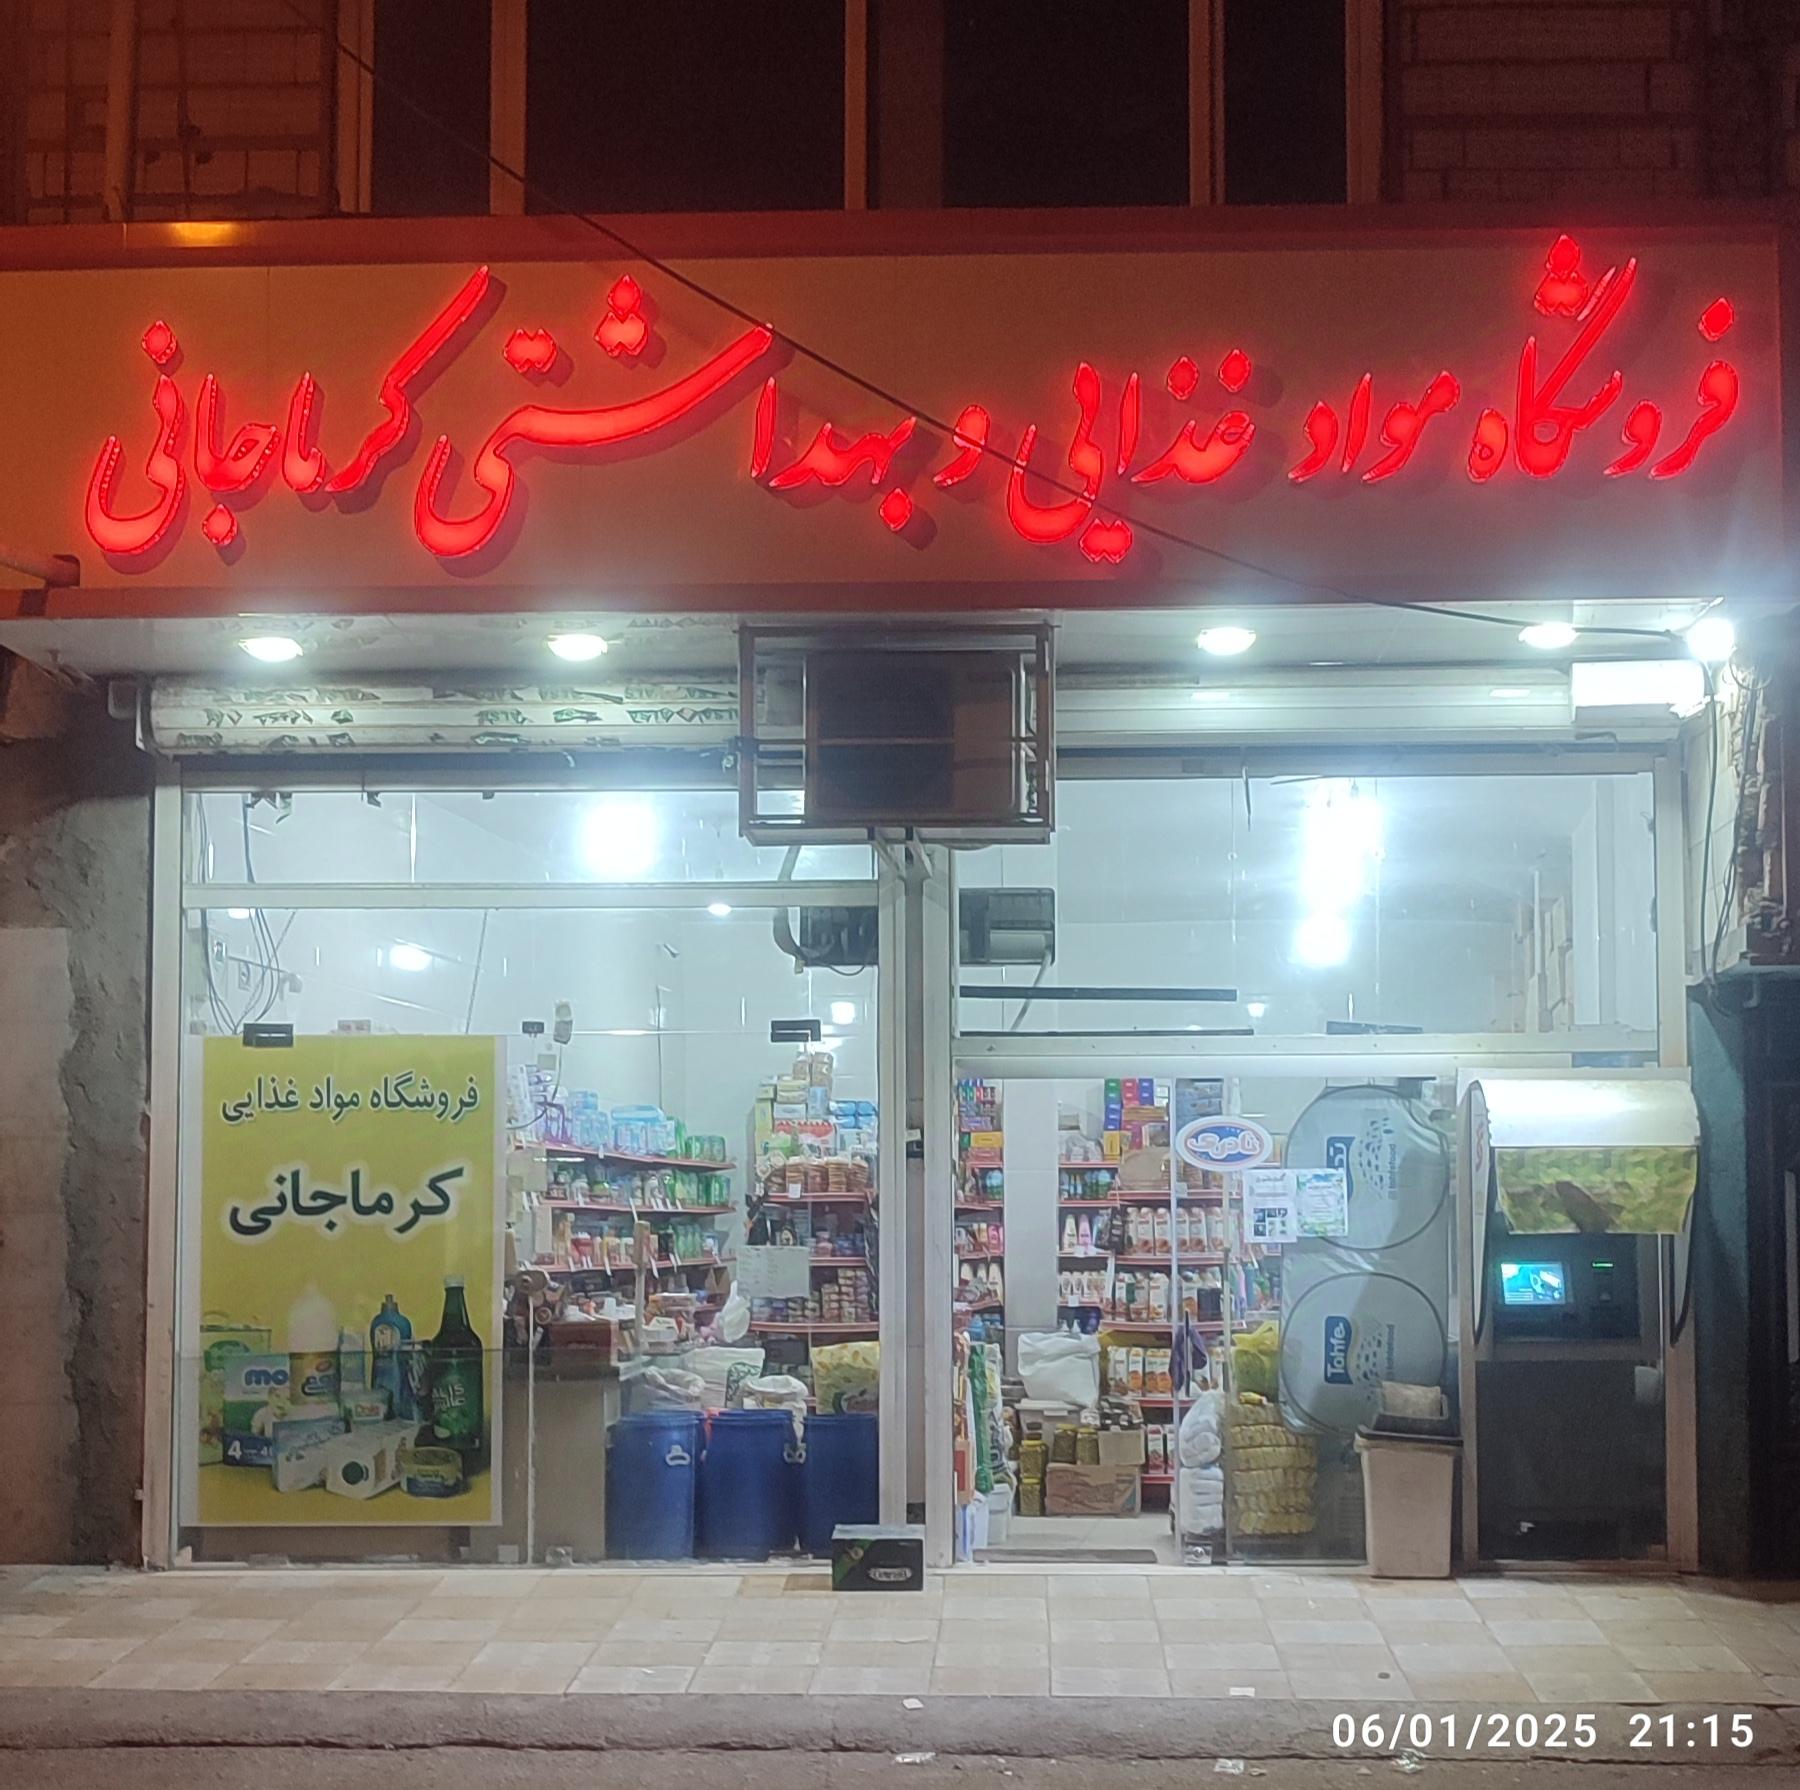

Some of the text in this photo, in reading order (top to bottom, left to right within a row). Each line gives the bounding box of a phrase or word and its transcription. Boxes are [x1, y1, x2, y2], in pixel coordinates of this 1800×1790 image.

[85, 234, 1739, 563] فروشگاه مواد غذایی و بهداشتی کرماجانی
[222, 1070, 479, 1122] فروشگاه مواد غذایی
[229, 1167, 464, 1236] کرماجانی
[1327, 1322, 1346, 1377] Tohfe
